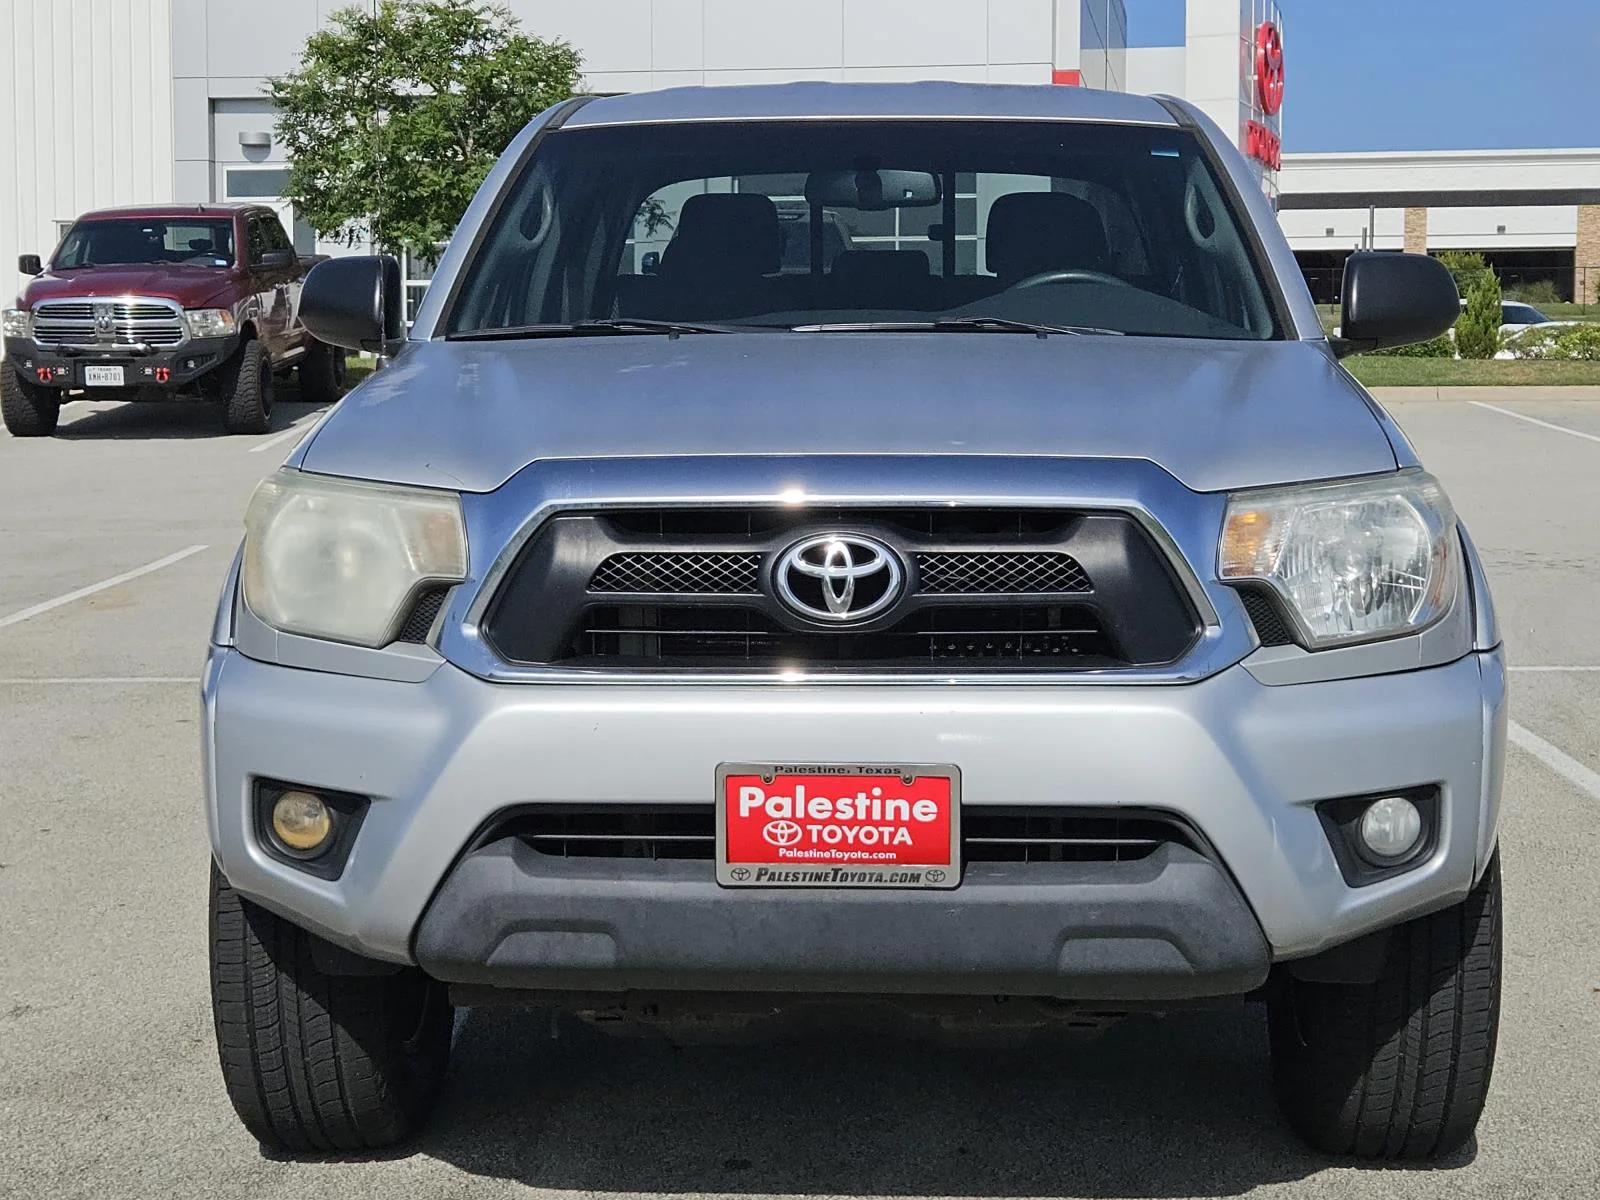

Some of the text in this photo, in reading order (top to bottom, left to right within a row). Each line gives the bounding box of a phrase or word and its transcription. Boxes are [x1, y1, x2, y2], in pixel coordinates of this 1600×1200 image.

[774, 765, 901, 775] Palestine, Texas
[739, 785, 938, 822] Palestine
[806, 824, 913, 845] TOYOTA
[778, 848, 897, 860] PalestineToyota.com
